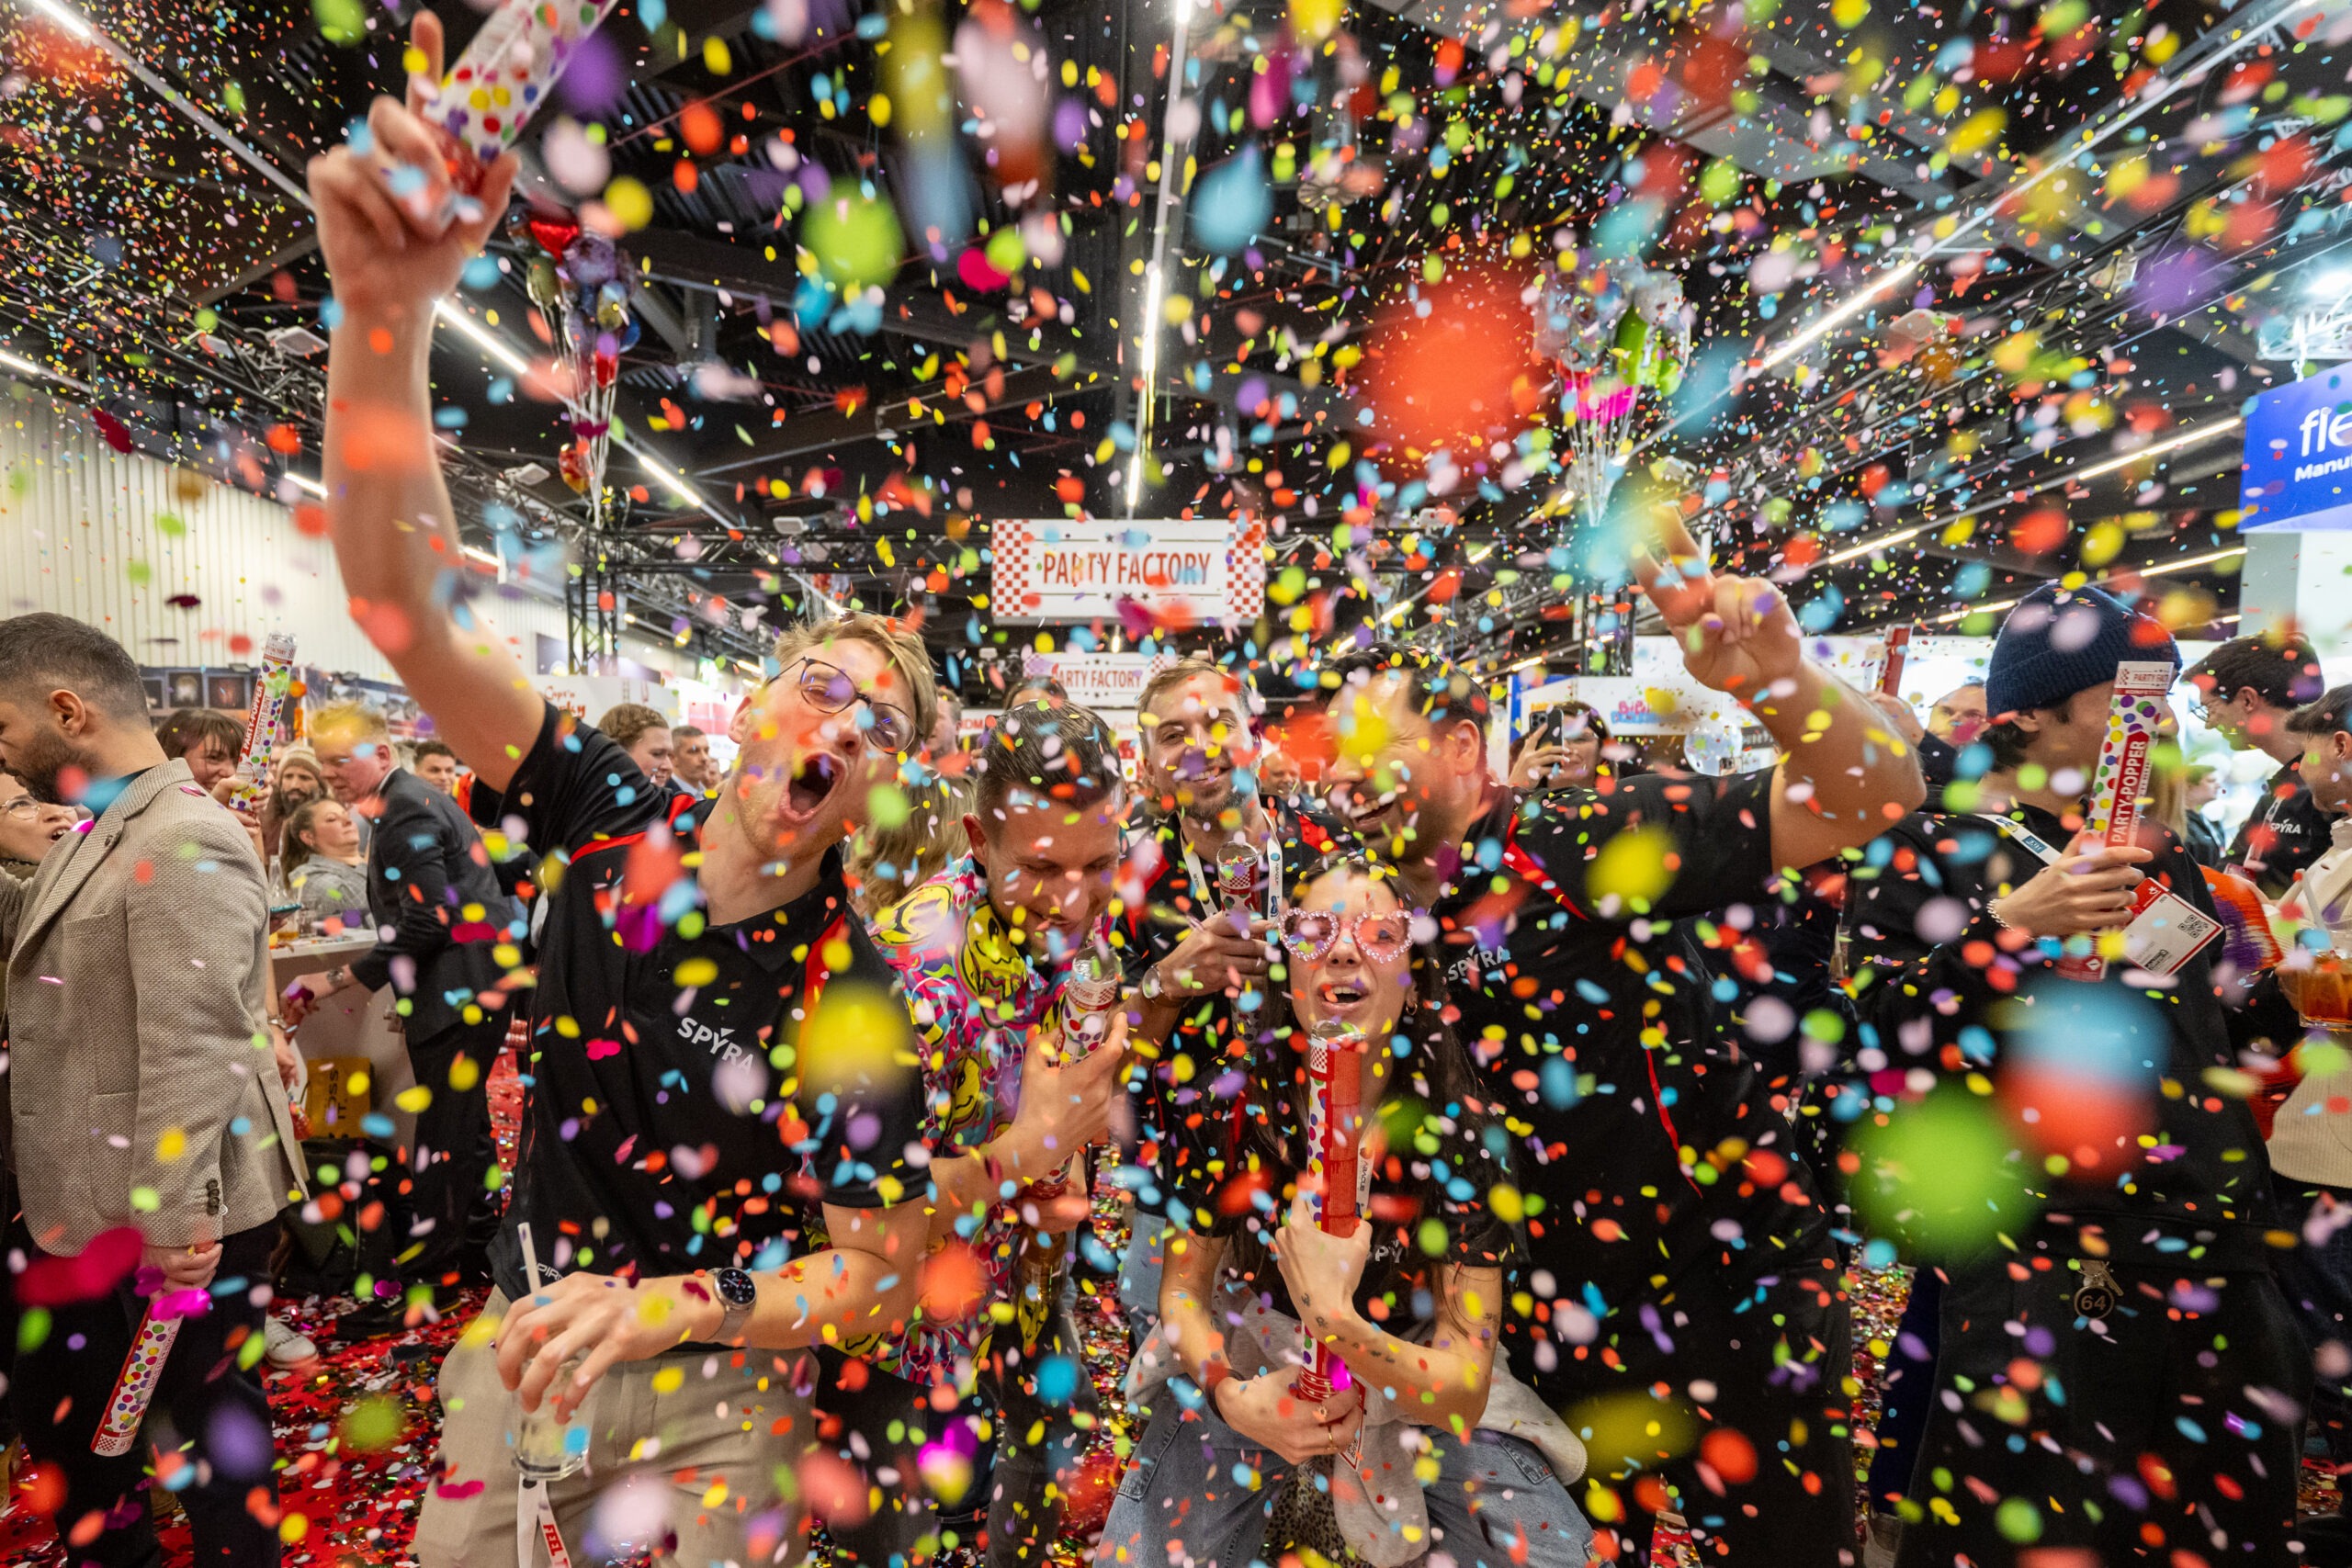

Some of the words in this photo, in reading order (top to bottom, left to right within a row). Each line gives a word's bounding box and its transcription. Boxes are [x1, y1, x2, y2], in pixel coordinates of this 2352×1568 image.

[2294, 454, 2352, 482] Manu
[1043, 552, 1112, 584] PARTY
[1117, 552, 1211, 584] FACTORY
[1056, 670, 1088, 687] ARTY
[1091, 670, 1141, 687] FACTORY
[243, 685, 264, 750] PARTY-POPPER
[254, 713, 268, 746] KONFETTI
[263, 695, 272, 714] BUNT
[2110, 740, 2146, 843] PARTY-POPPER
[2269, 818, 2301, 834] SPYRA
[676, 1017, 753, 1076] SPYRA
[2081, 1295, 2107, 1311] 64
[543, 1524, 563, 1556] FEEL
